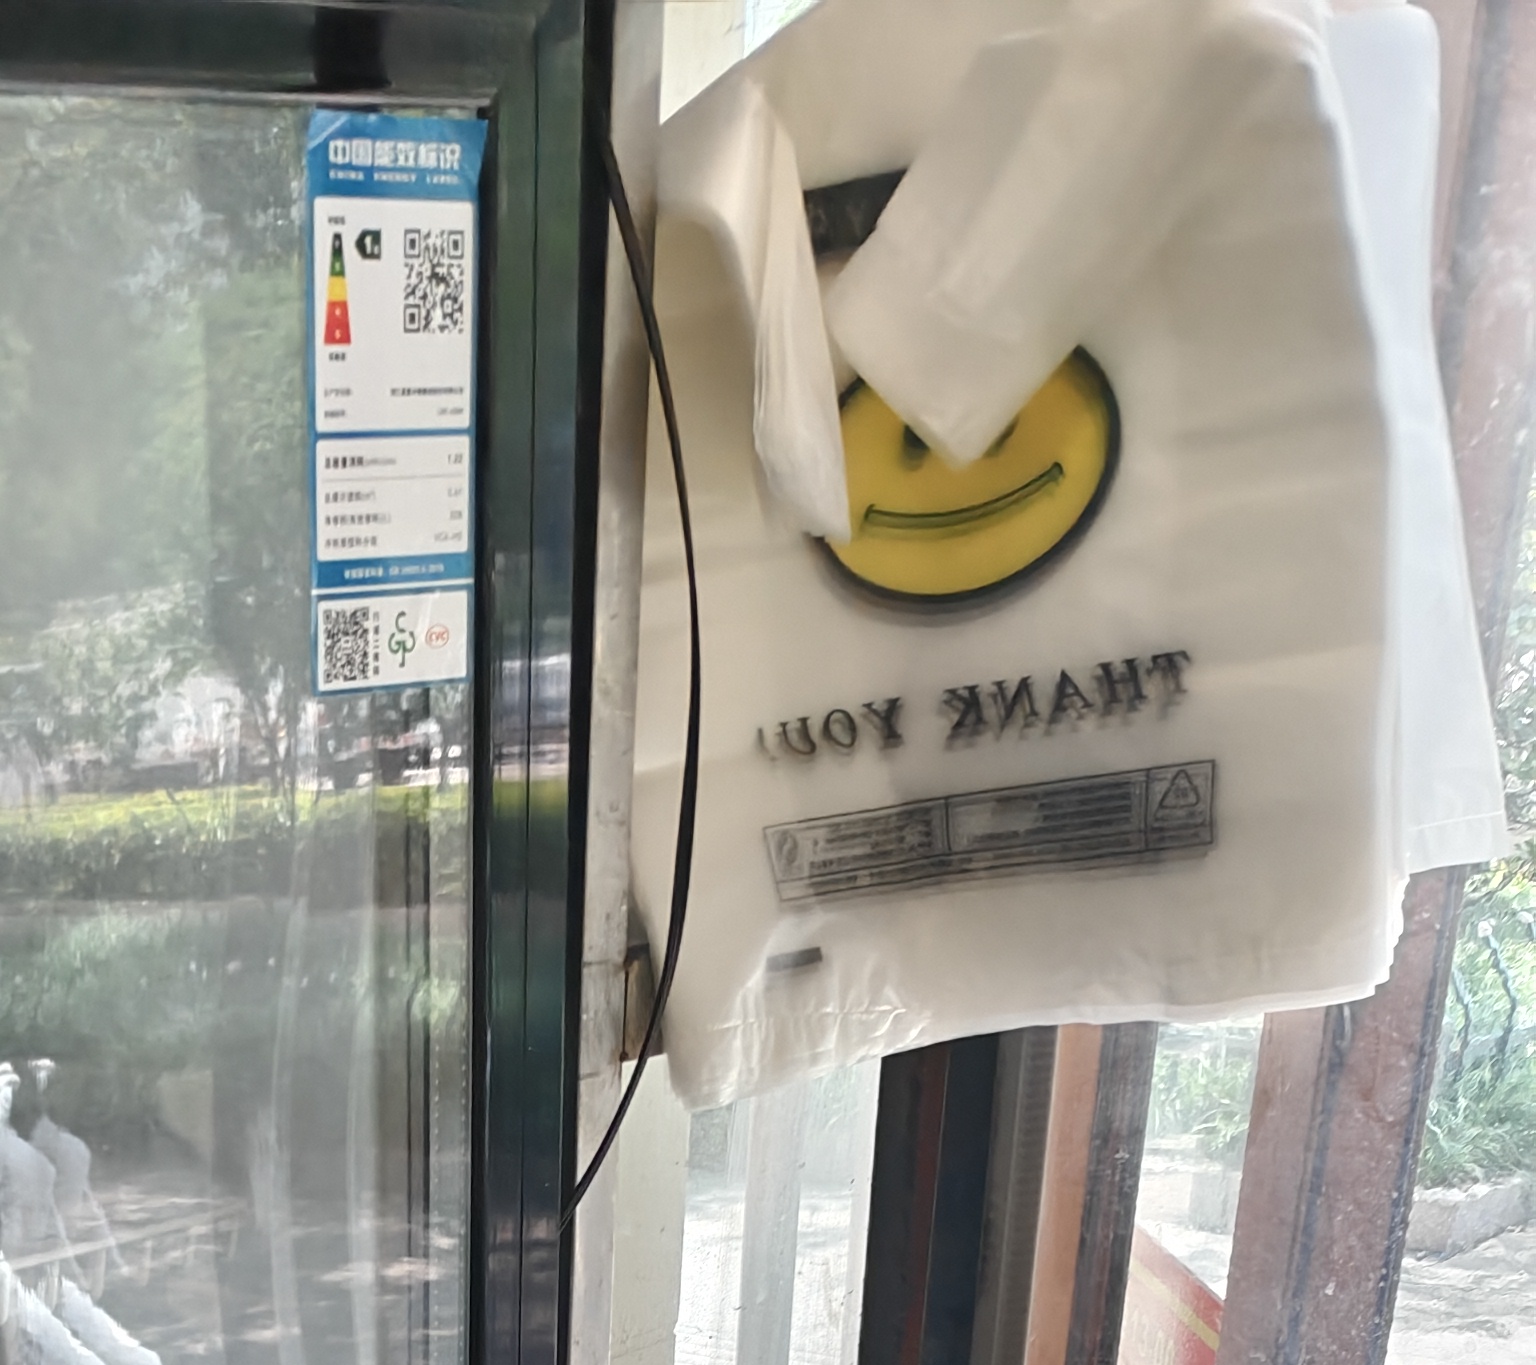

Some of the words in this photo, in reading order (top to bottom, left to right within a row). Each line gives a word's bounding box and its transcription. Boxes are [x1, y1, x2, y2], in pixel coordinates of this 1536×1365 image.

[328, 138, 462, 171] 中国能效标识
